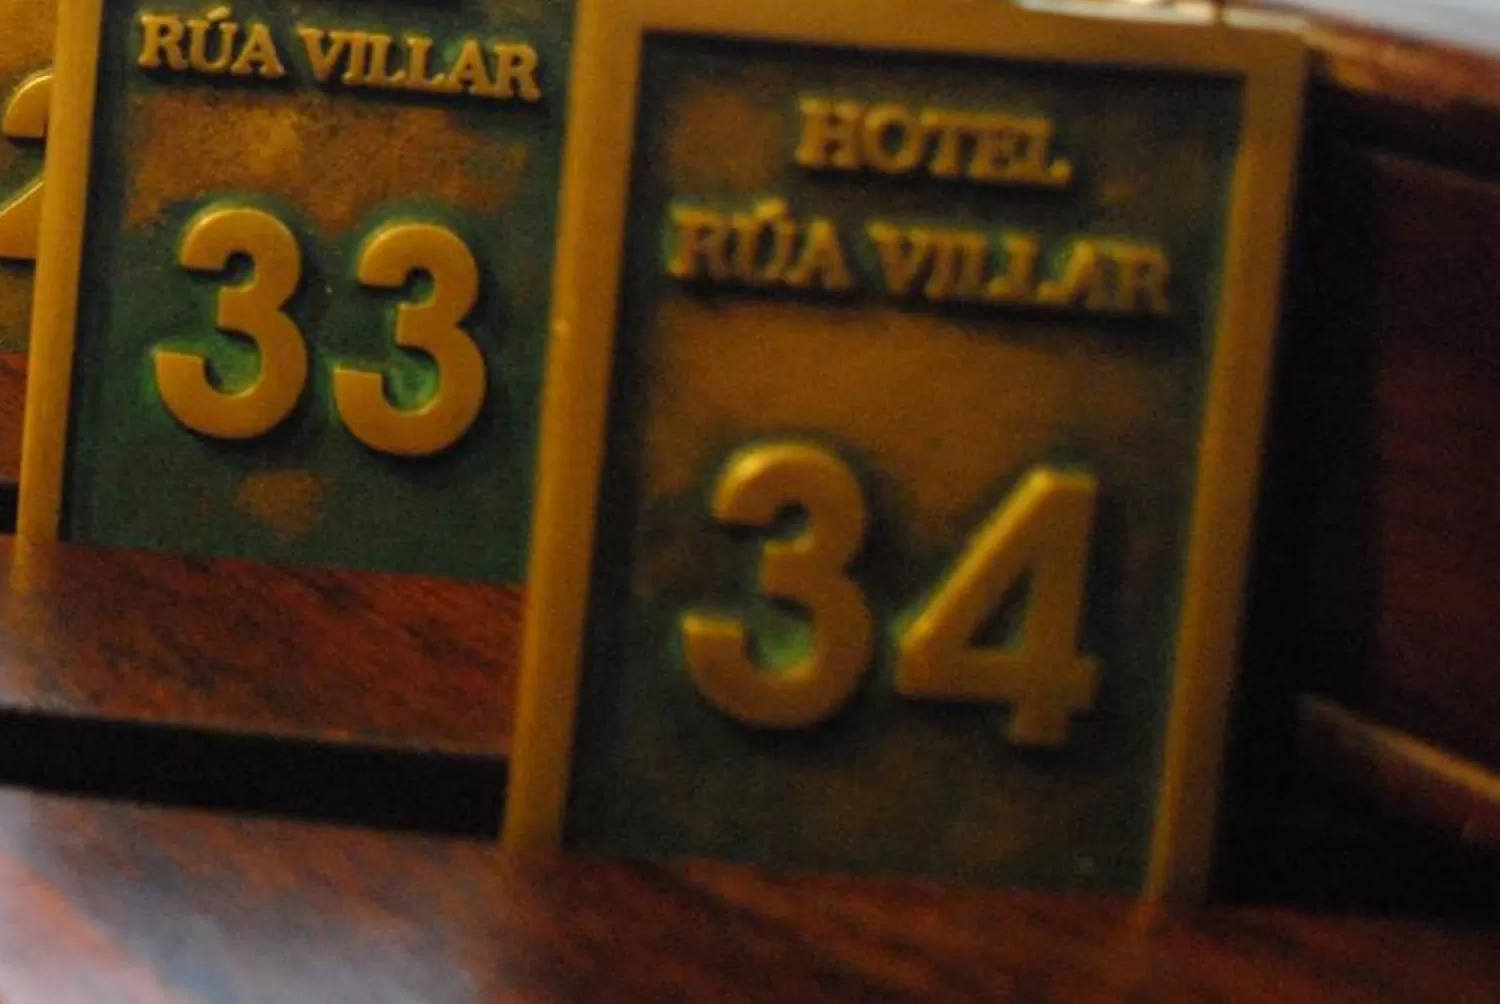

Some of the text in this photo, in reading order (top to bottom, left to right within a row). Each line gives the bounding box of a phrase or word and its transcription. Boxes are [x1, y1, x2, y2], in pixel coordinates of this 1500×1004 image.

[137, 7, 542, 102] RÚA VILLAR
[795, 97, 1074, 185] HOTEL
[670, 199, 1172, 315] RÚA VILLAR
[154, 206, 488, 458] 33
[681, 441, 1100, 746] 34
